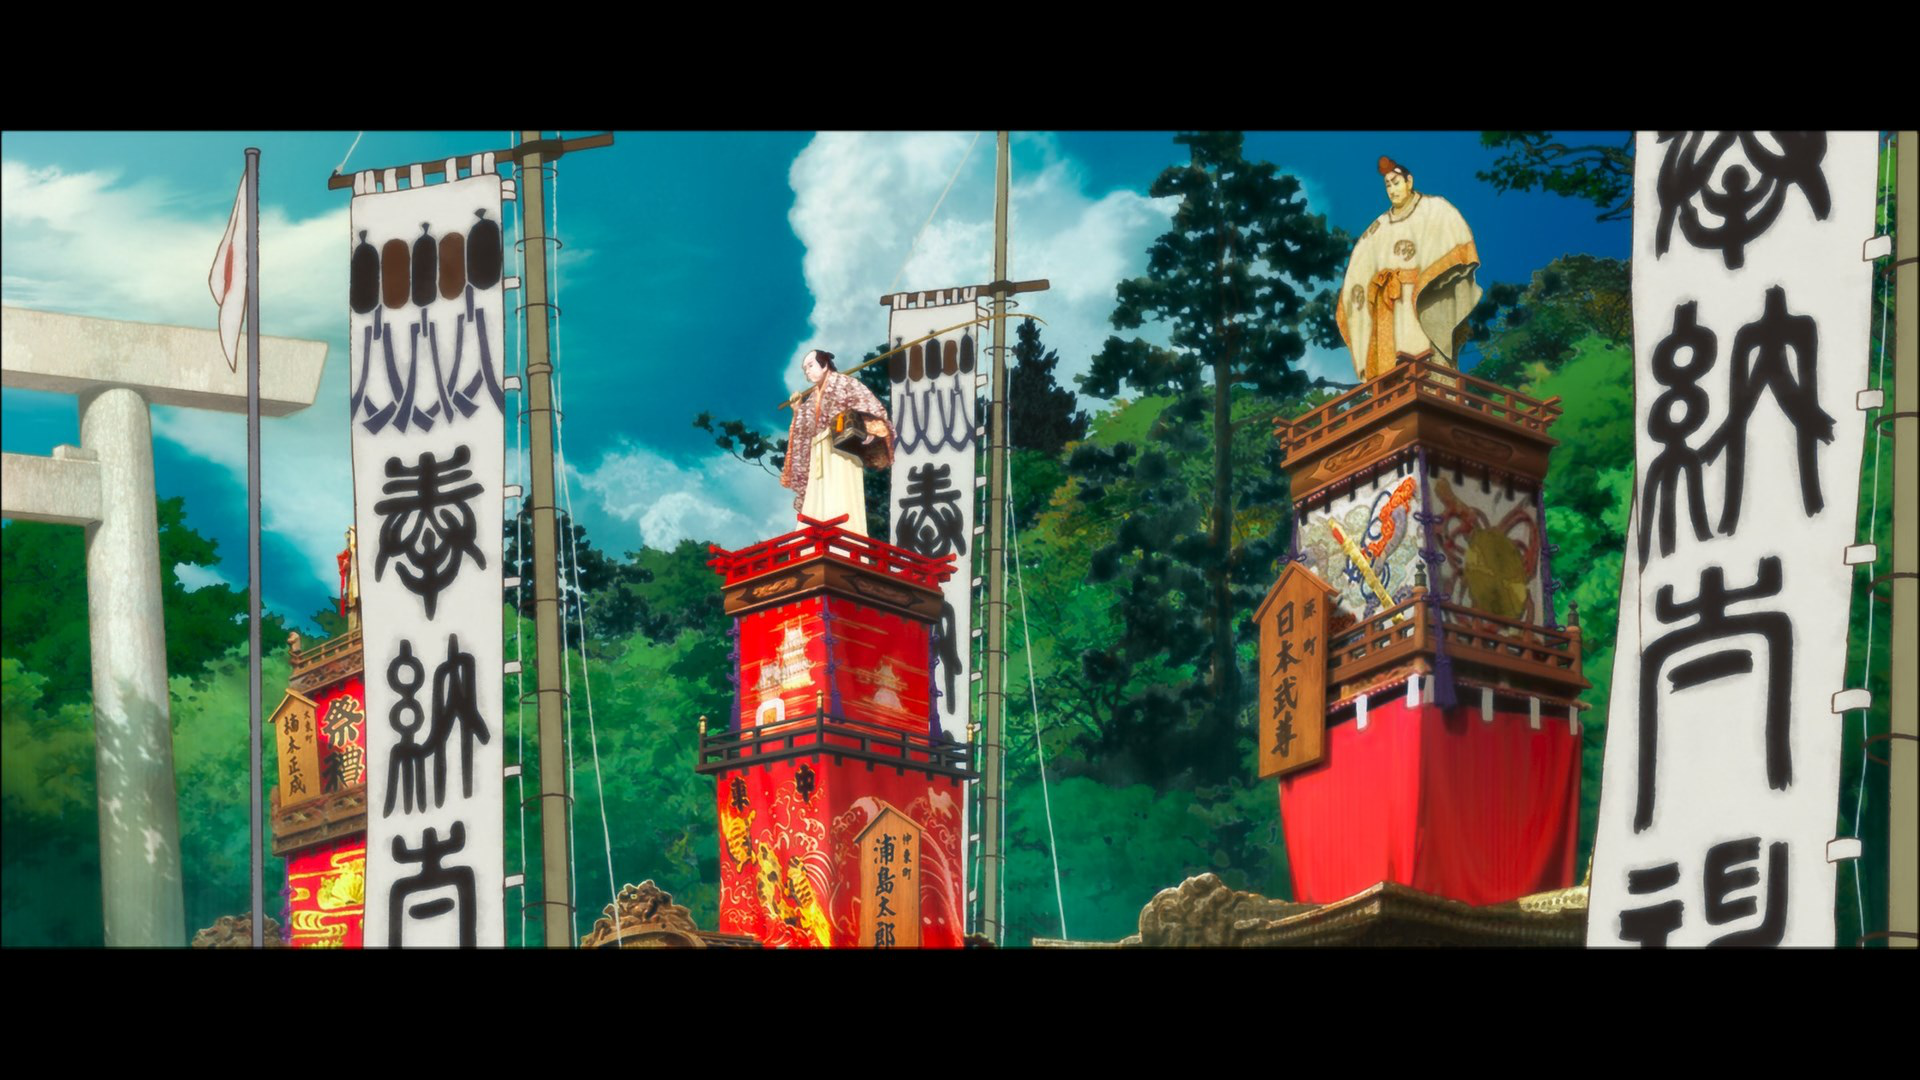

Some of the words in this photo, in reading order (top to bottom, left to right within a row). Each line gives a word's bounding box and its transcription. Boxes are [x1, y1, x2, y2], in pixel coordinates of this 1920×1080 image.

[1271, 600, 1302, 758] 日本武尊
[283, 713, 306, 797] 楠木正成
[874, 834, 897, 947] 浦島太郎
